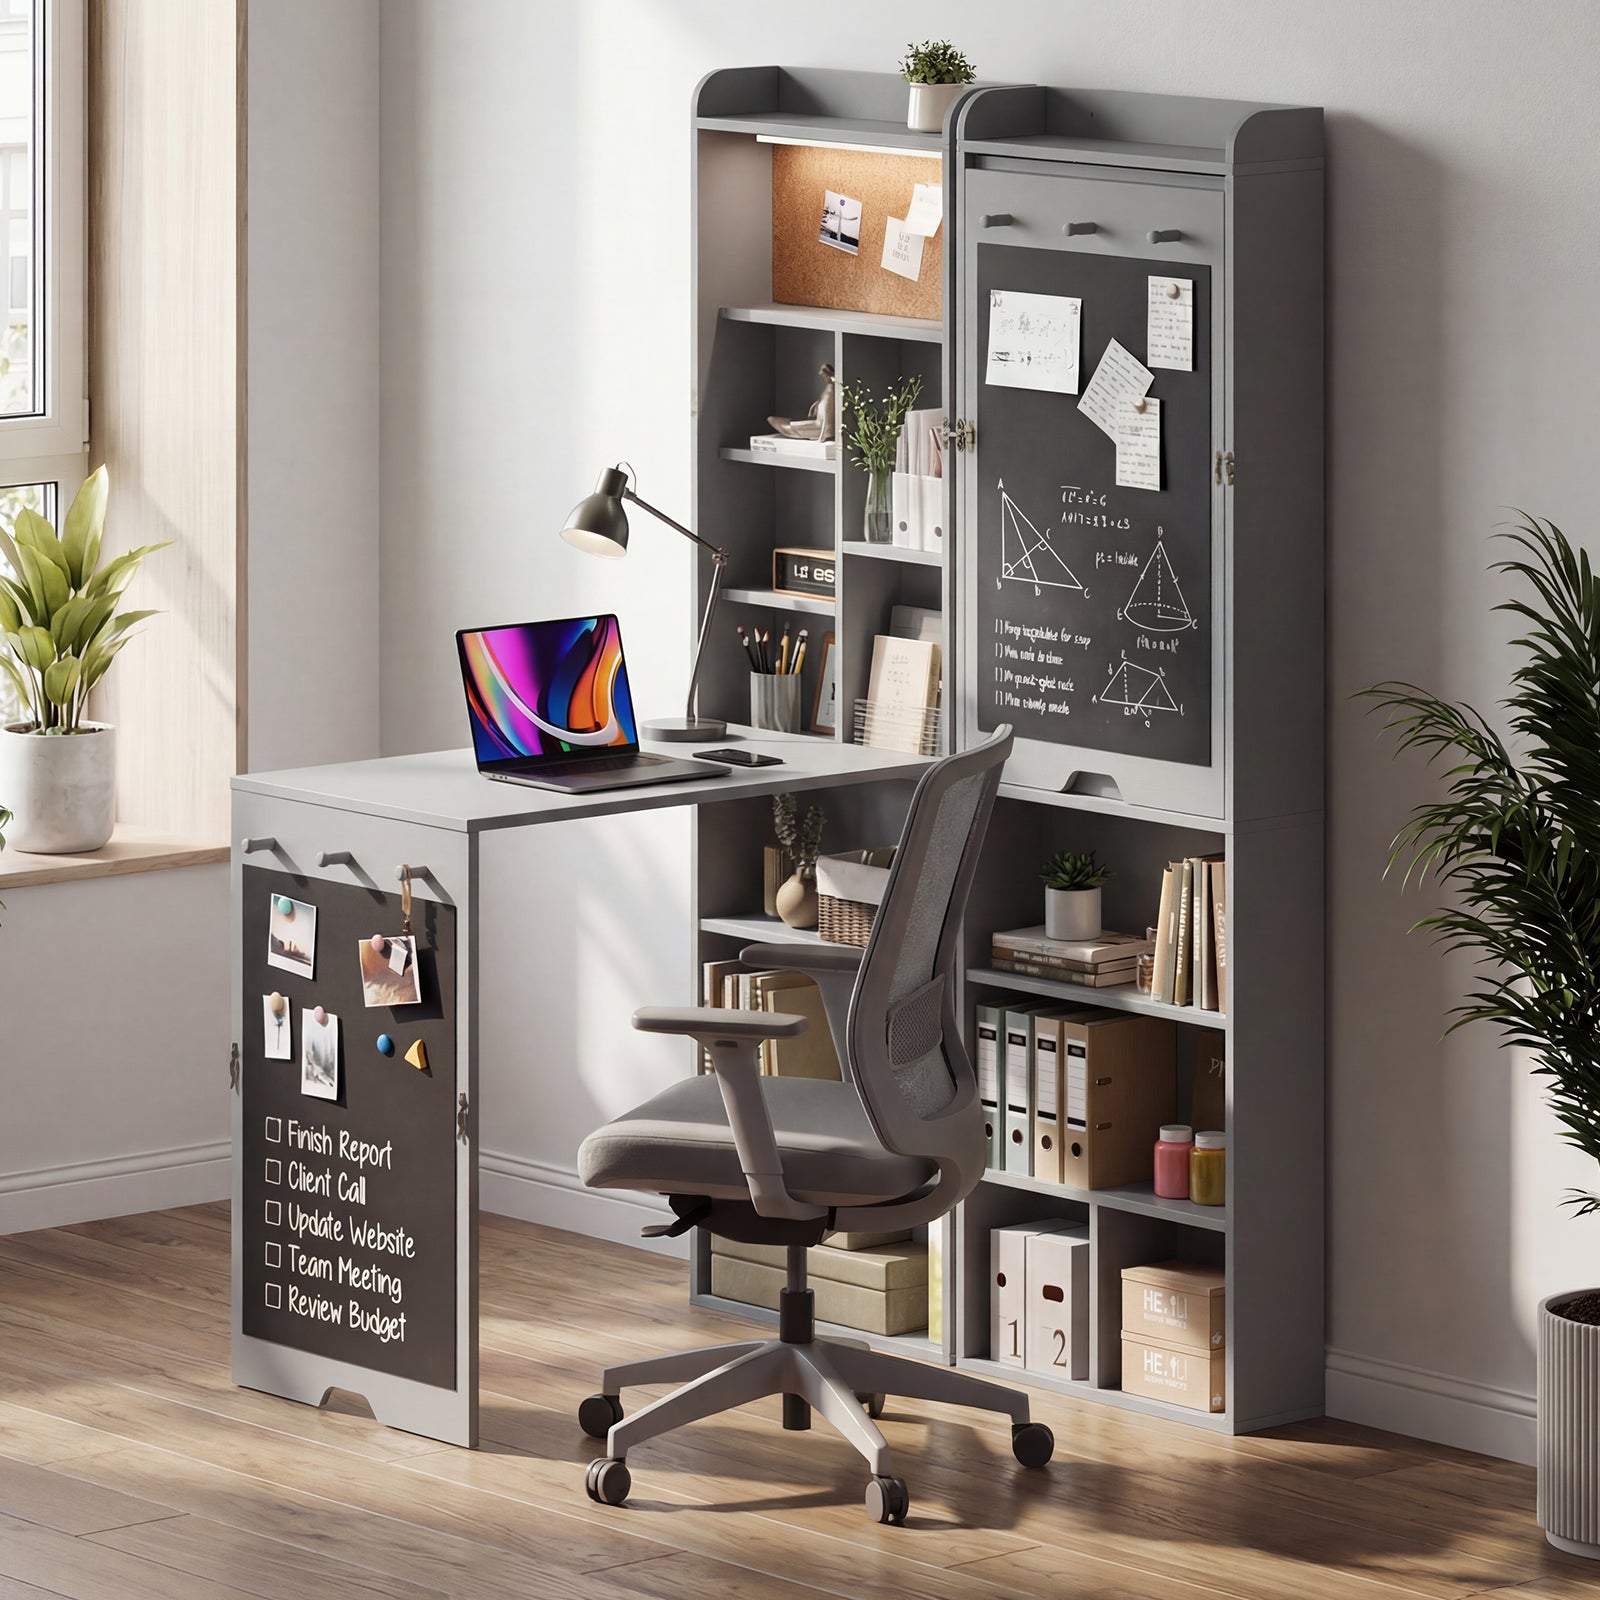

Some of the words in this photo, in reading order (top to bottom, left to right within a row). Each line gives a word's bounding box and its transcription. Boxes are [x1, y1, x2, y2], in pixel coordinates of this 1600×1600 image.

[288, 1119, 333, 1155] Finish
[339, 1129, 392, 1170] Report
[288, 1160, 331, 1198] Client
[337, 1171, 366, 1206] Call
[288, 1202, 344, 1242] Update
[349, 1215, 416, 1258] Website
[287, 1243, 333, 1281] Team
[338, 1256, 402, 1304] Meeting
[288, 1283, 342, 1325] Review
[349, 1299, 407, 1343] Budget
[1007, 1318, 1022, 1358] 1
[1052, 1328, 1067, 1368] 2
